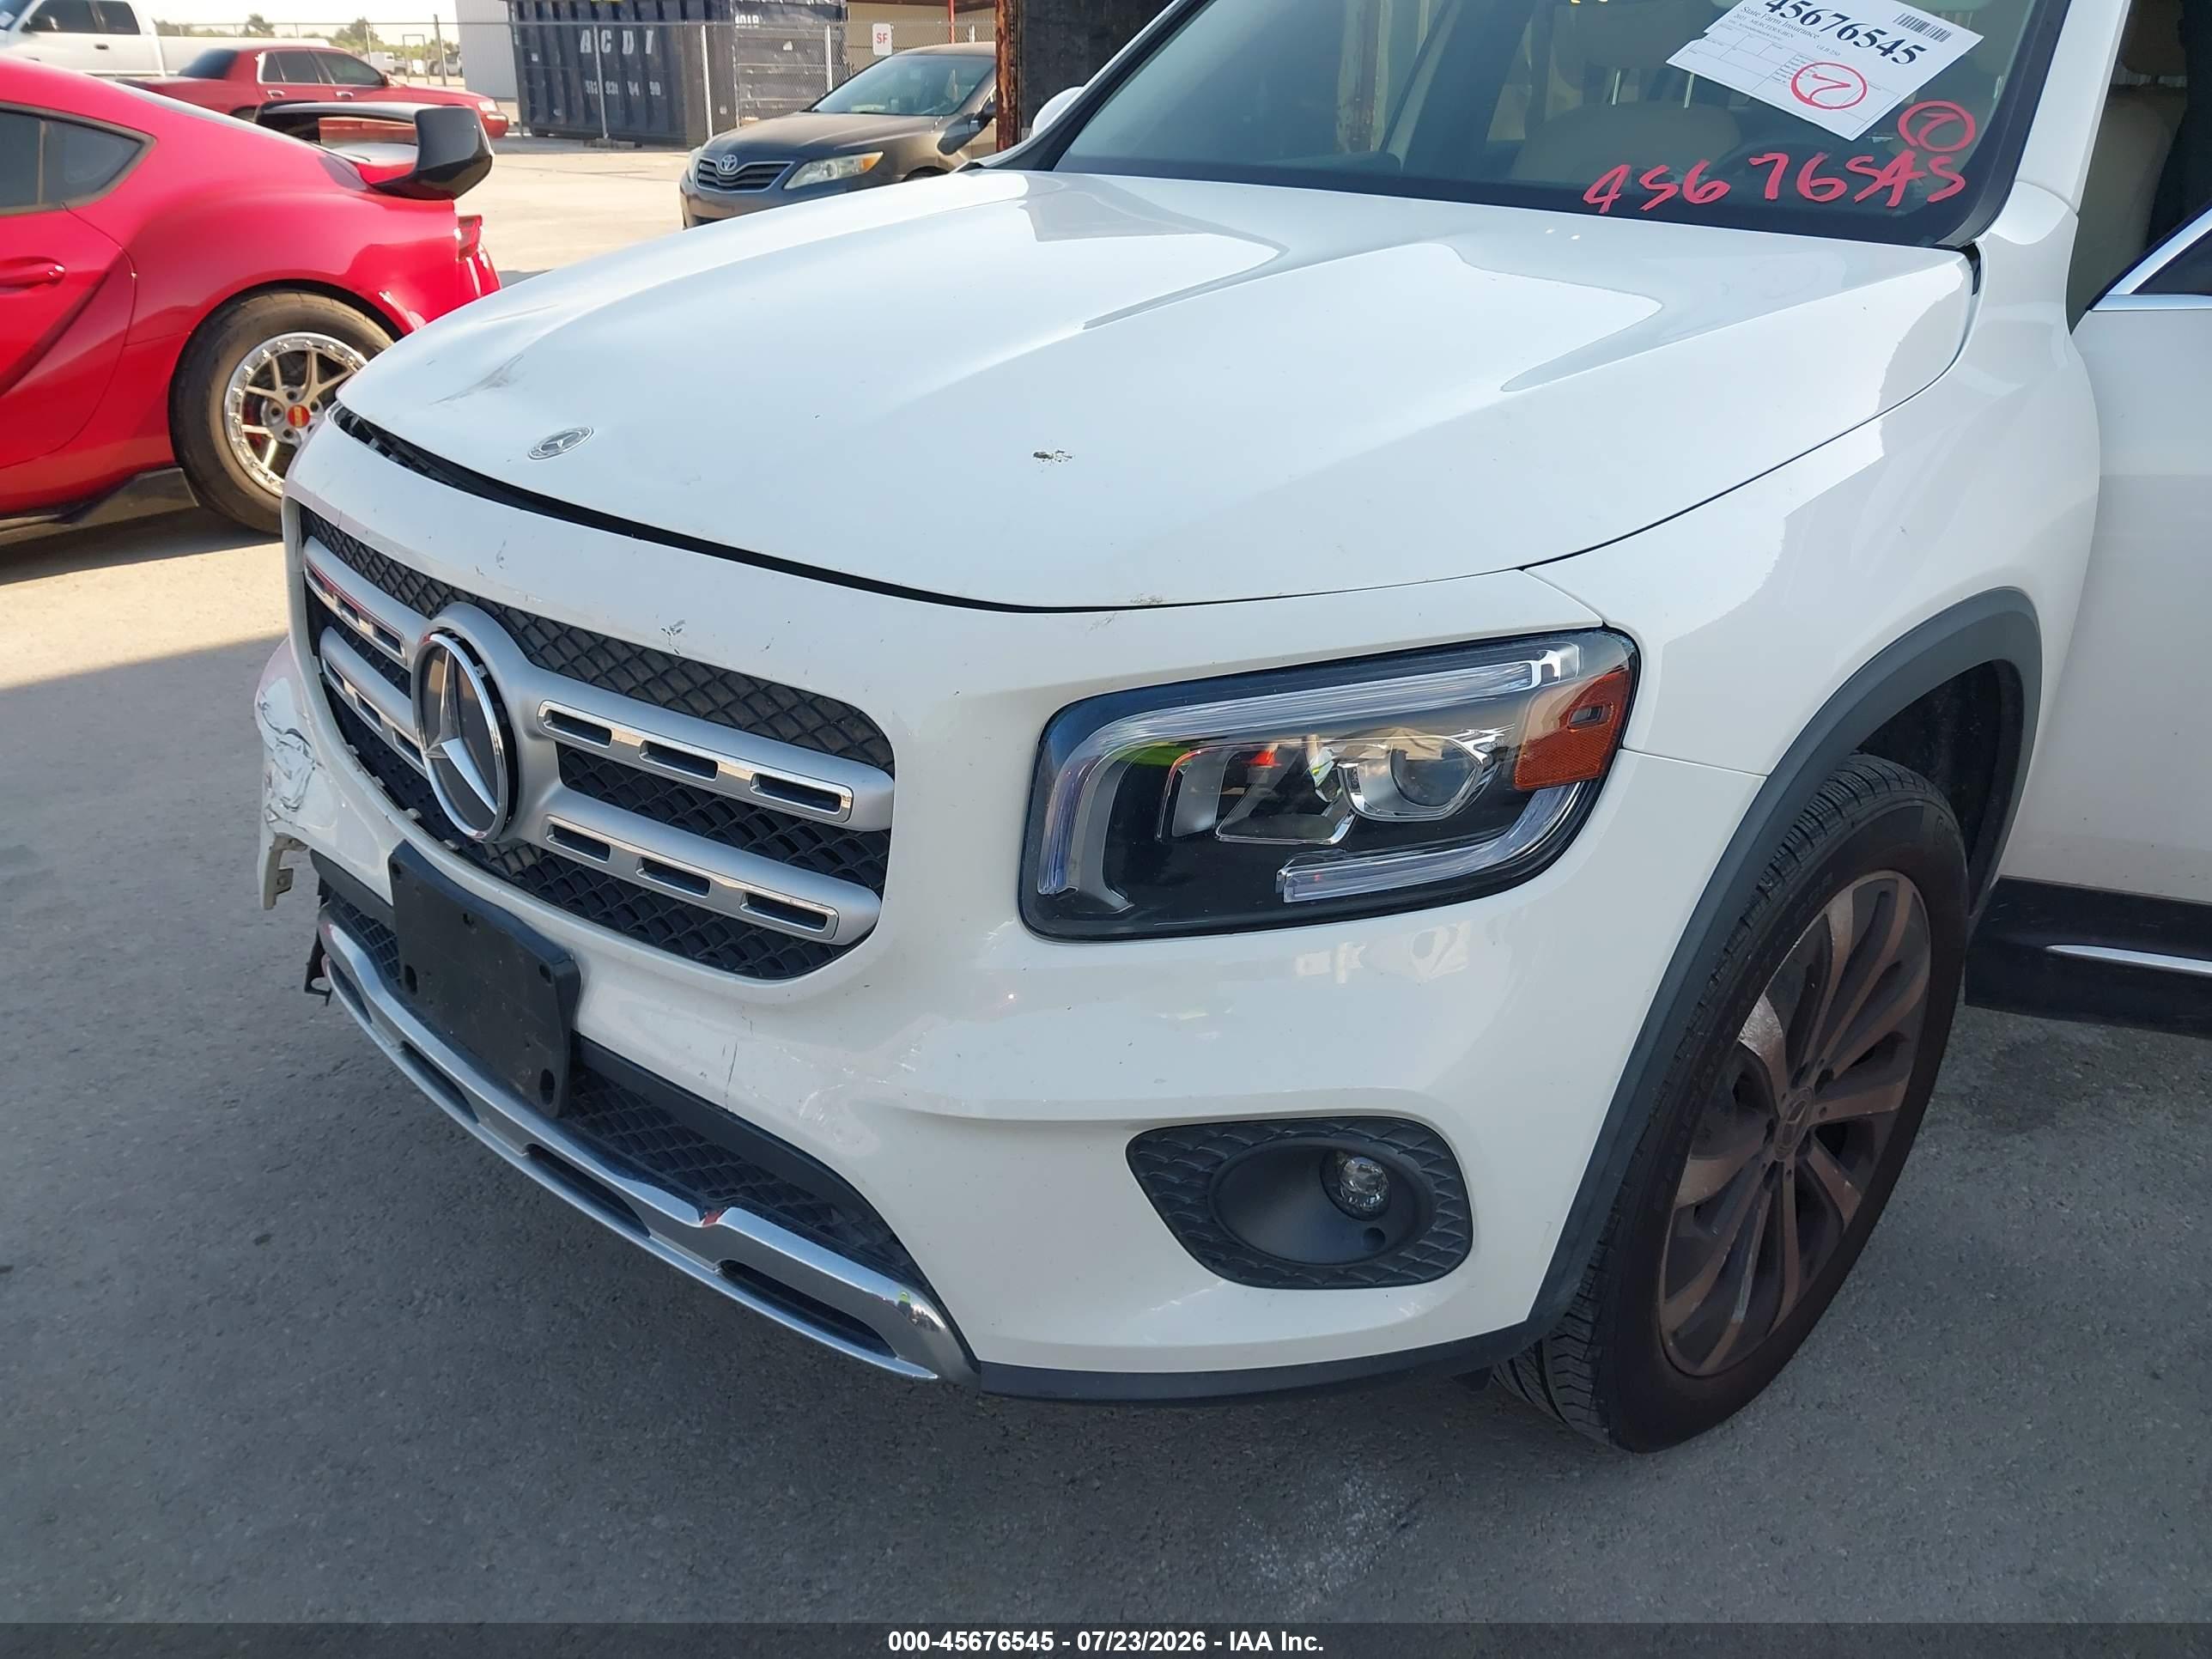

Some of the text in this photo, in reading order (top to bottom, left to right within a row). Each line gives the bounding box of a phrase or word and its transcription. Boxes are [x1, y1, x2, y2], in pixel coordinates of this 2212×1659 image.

[877, 33, 888, 44] SF
[1741, 6, 1761, 17] State
[1761, 13, 1782, 26] Farm
[1782, 21, 1820, 40] Insurance
[1765, 0, 1928, 64] 45676545
